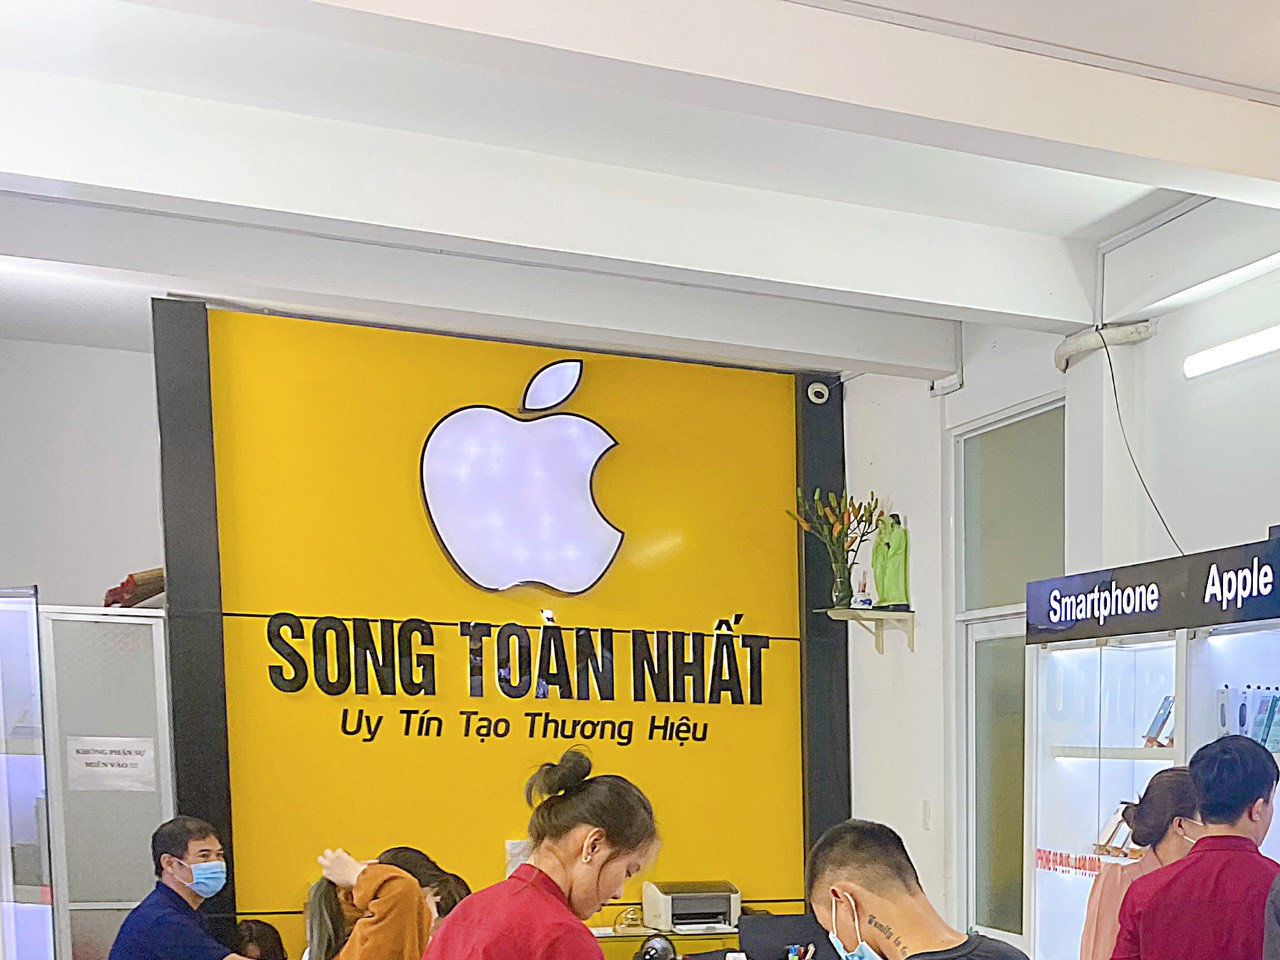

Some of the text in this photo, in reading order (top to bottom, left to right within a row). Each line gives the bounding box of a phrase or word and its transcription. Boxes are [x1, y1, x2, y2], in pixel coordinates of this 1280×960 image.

[1049, 580, 1160, 625] Smartphone
[1203, 557, 1273, 610] Apple
[266, 609, 770, 705] SONG TOÀN NHẤT
[340, 708, 709, 747] Uy Tín Tạo Thương Hiệu
